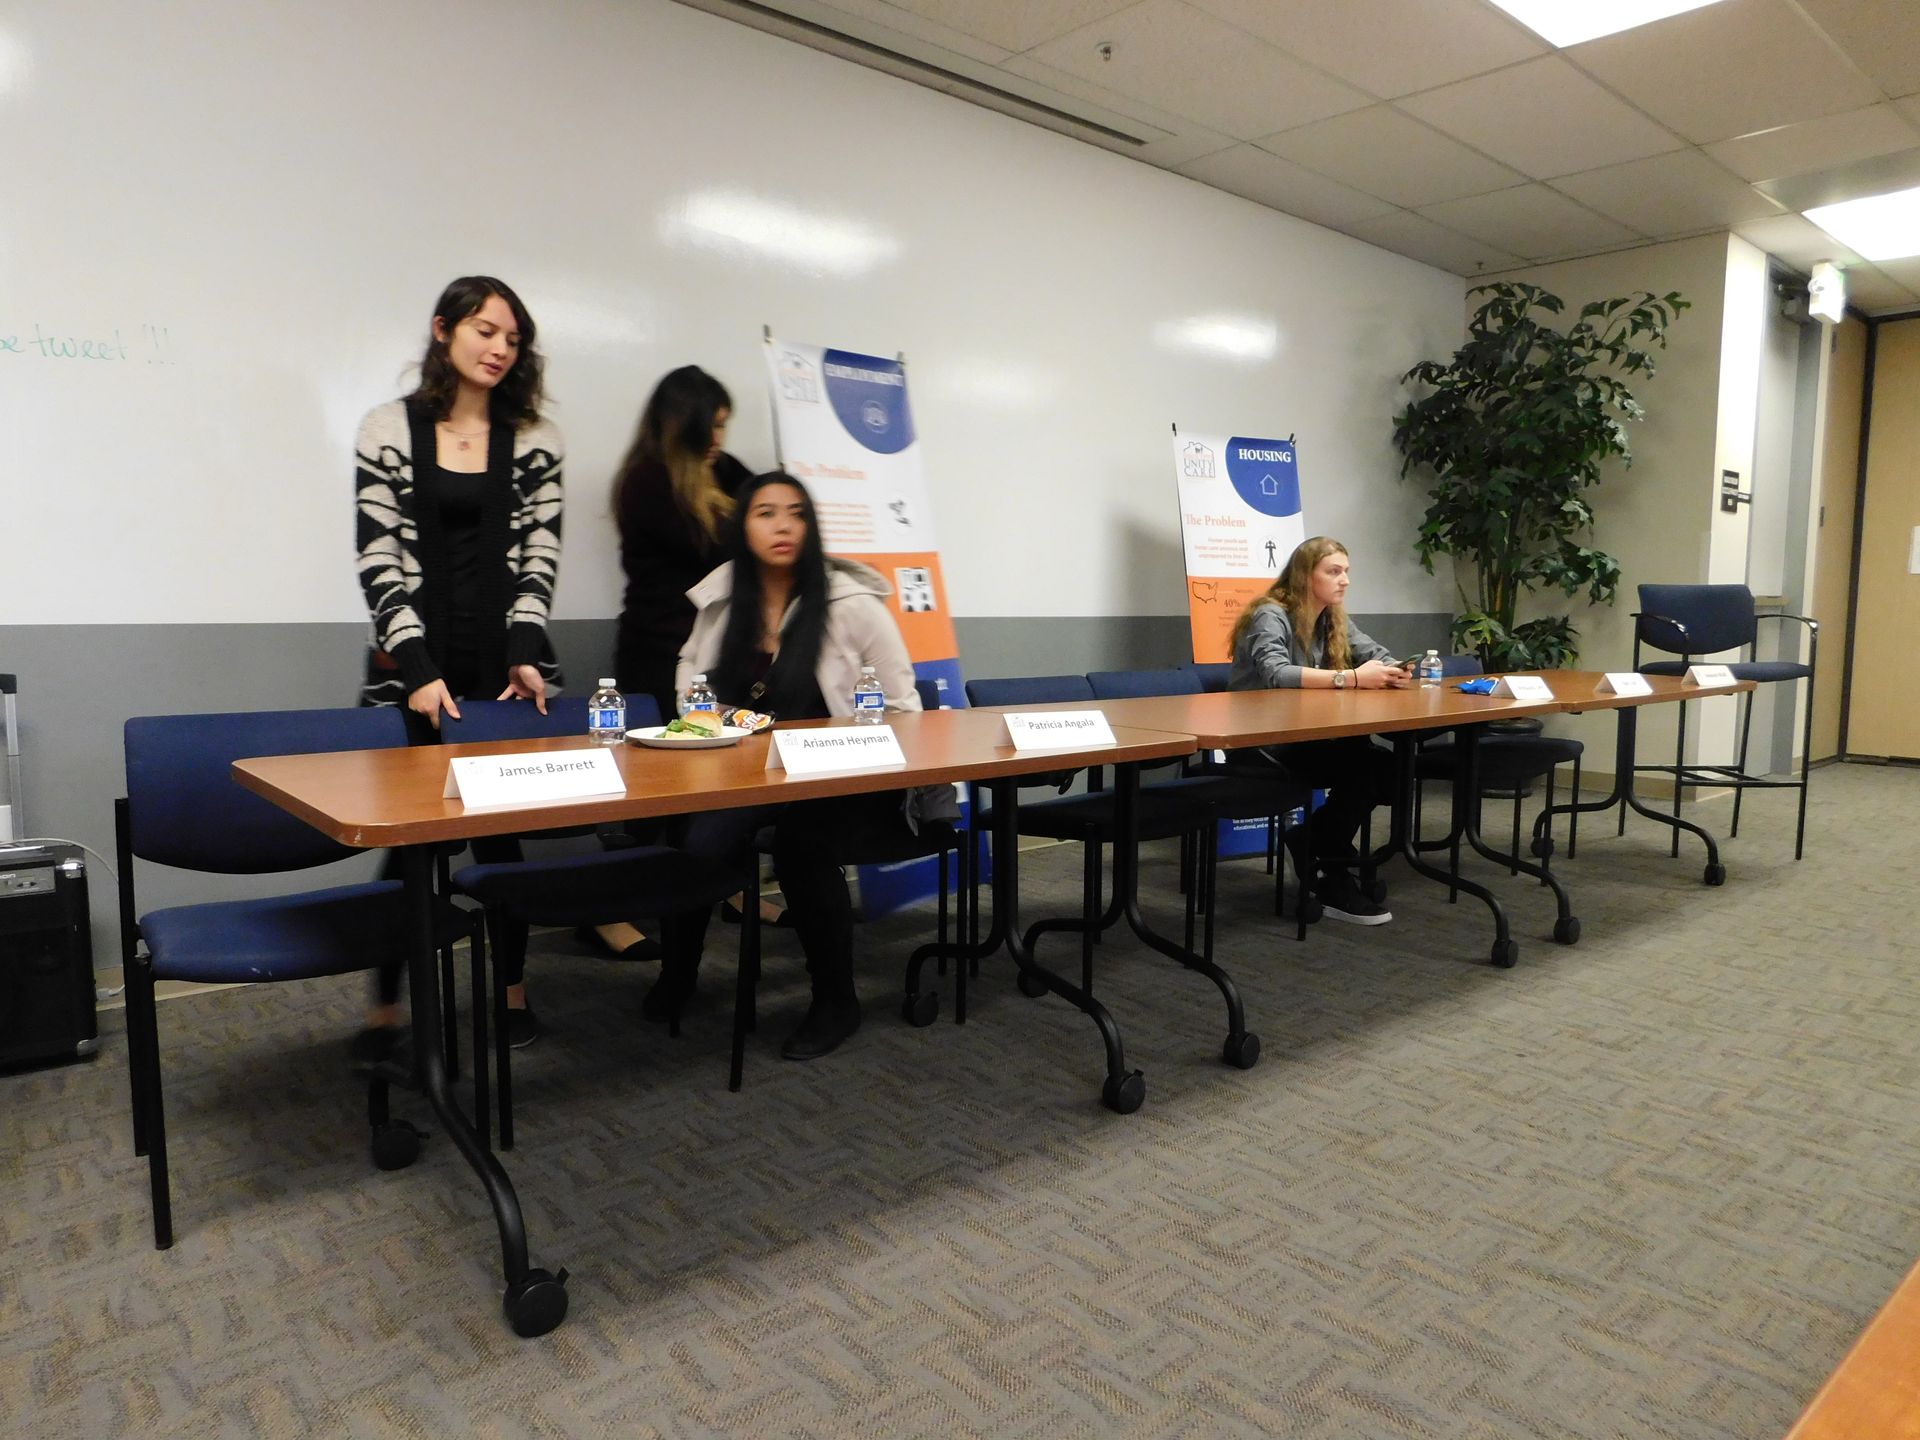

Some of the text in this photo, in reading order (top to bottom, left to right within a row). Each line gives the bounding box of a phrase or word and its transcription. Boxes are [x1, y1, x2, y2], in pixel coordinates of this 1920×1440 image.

[29, 323, 128, 360] tweet
[1238, 448, 1292, 463] HOUSING
[1185, 514, 1246, 528] The Problem
[1028, 718, 1095, 730] Patricia Angala
[803, 735, 890, 749] Arianna Heyman
[499, 759, 596, 777] James Barrett
